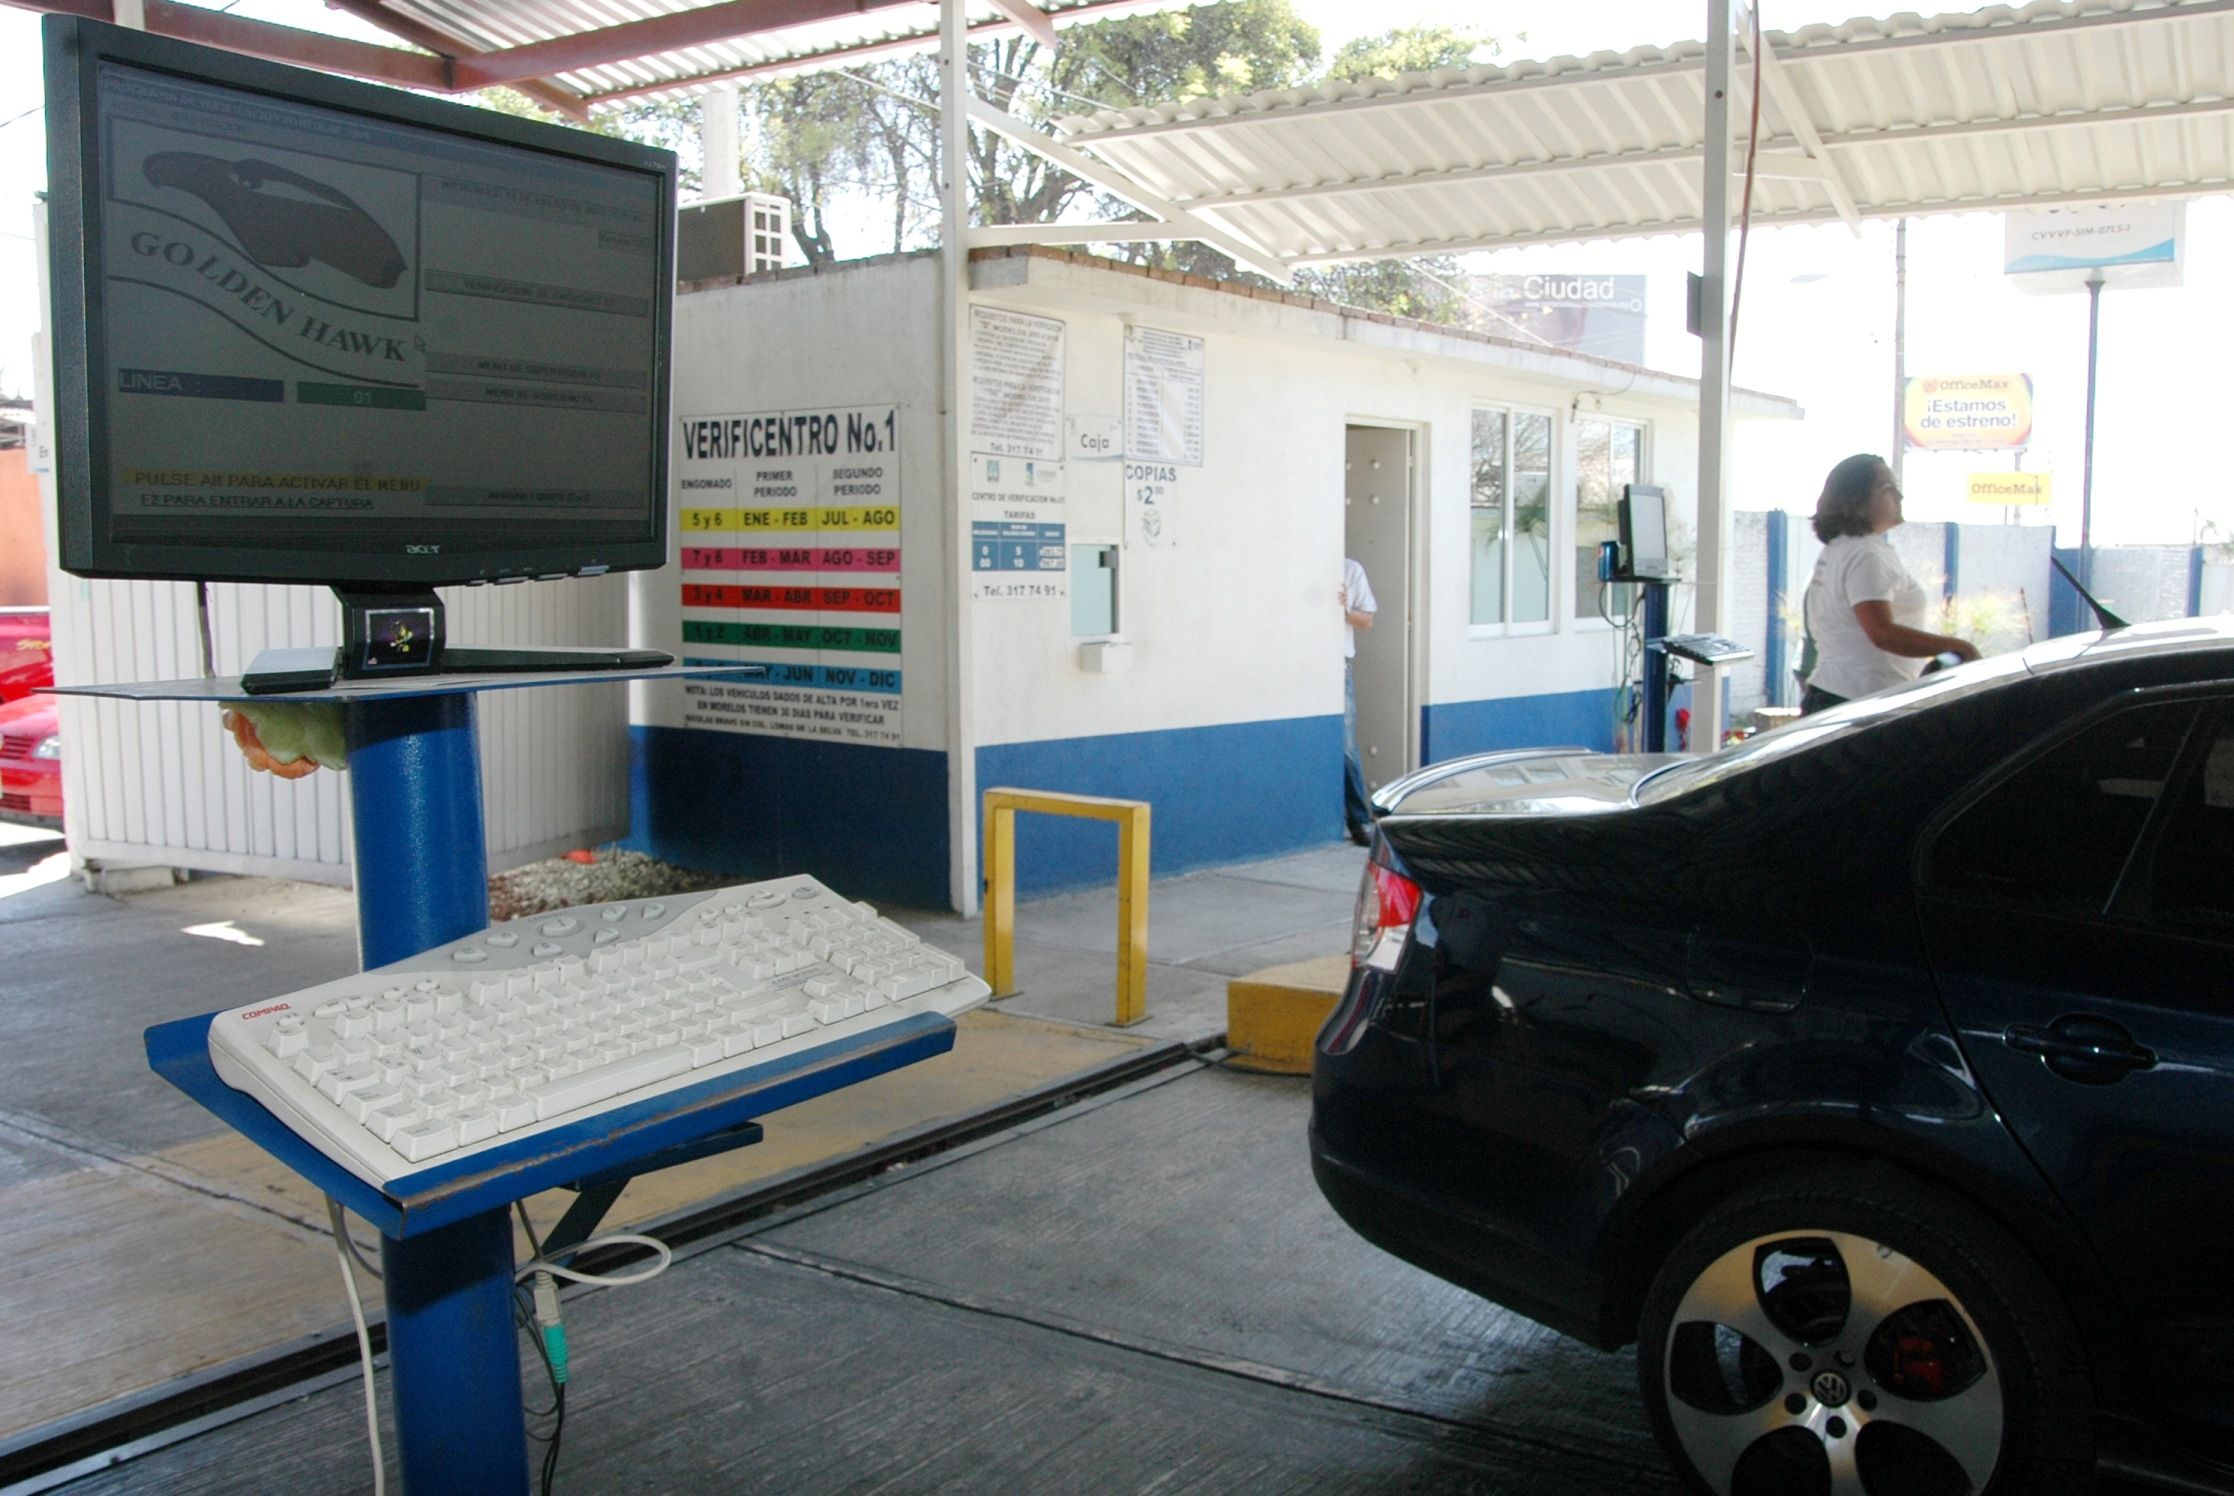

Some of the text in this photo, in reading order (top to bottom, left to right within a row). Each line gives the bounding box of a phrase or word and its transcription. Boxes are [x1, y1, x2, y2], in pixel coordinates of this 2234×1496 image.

[131, 232, 407, 361] GOLDEN HAWK
[1523, 276, 1615, 300] Ciudad
[119, 371, 184, 391] LINEA
[1940, 380, 2008, 391] OfficeMax
[1927, 399, 2006, 412] ¡Estamos
[1920, 416, 1941, 428] de
[683, 414, 838, 459] VERIFICENTRO
[1080, 433, 1109, 452] Caja
[135, 471, 195, 486] PULSE
[228, 474, 274, 488] PARA
[278, 476, 348, 489] ACTIVAR
[354, 478, 371, 490] EL
[377, 478, 420, 491] MENU
[756, 470, 793, 481] PRIMER
[832, 467, 883, 480] SEGUNDO
[1125, 464, 1176, 482] COPIAS
[682, 479, 732, 490] ENGOMADO
[754, 486, 797, 498] PERIODO
[834, 484, 881, 496] PERIODO
[1971, 484, 2041, 494] OfficeMax
[162, 495, 206, 506] PARA
[209, 495, 272, 507] ENTRAR
[308, 497, 374, 509] CAPTURA
[692, 513, 700, 526] 5
[704, 515, 711, 529] y
[714, 512, 722, 526] 6
[743, 512, 770, 526] ENE
[782, 511, 808, 525] FEB
[822, 510, 849, 525] JUL
[862, 509, 895, 525] AGO
[1003, 510, 1036, 520] TARIFAS
[693, 550, 699, 562] 7
[704, 553, 711, 567] y
[714, 551, 722, 563] 8
[742, 550, 767, 564] FEB
[779, 551, 811, 565] MAR
[822, 551, 853, 565] AGO
[866, 551, 895, 565] SEP
[742, 589, 771, 602] MAR
[784, 590, 811, 603] ABR
[823, 590, 850, 604] SEP
[864, 591, 894, 605] OCT
[983, 584, 1056, 597] Tel. 317 74 91
[743, 627, 770, 640] ABR
[782, 628, 811, 641] MAY
[822, 629, 853, 644] OCT
[865, 631, 897, 646] NOV
[784, 666, 813, 681] JUN
[825, 670, 856, 685] NOV
[869, 671, 895, 687] DIC
[709, 687, 724, 697] LOS
[727, 688, 770, 701] VEHICULOS
[803, 693, 813, 704] DE
[816, 695, 837, 706] ALTA
[840, 696, 858, 707] POR
[881, 699, 899, 711] VEZ
[697, 700, 707, 710] EN
[710, 701, 746, 713] MORELOS
[748, 704, 778, 715] TIENEN
[792, 708, 811, 719] DIAS
[814, 709, 835, 720] PARA
[838, 712, 885, 725] VERIFICAR
[241, 1003, 292, 1020] COMPAQ
